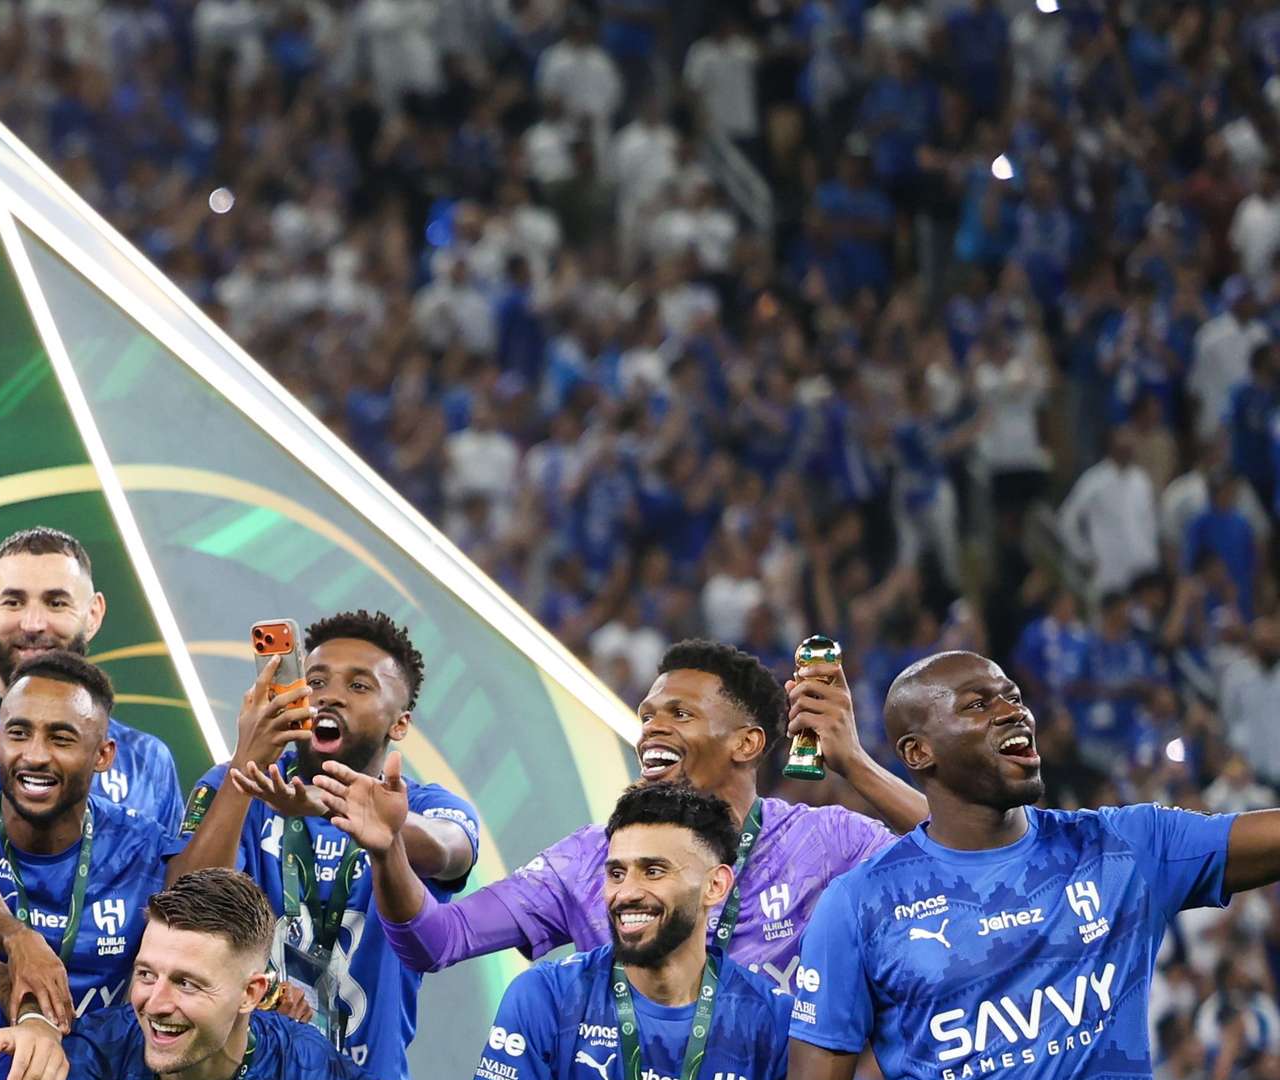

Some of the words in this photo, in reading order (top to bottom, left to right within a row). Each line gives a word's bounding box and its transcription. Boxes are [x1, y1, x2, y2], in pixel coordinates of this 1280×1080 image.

[894, 894, 947, 921] flynas
[977, 908, 1044, 935] Jahez
[796, 965, 820, 993] ee
[930, 963, 1116, 1061] SAVVY
[489, 1025, 527, 1057] ee
[480, 1057, 518, 1080] NABIL
